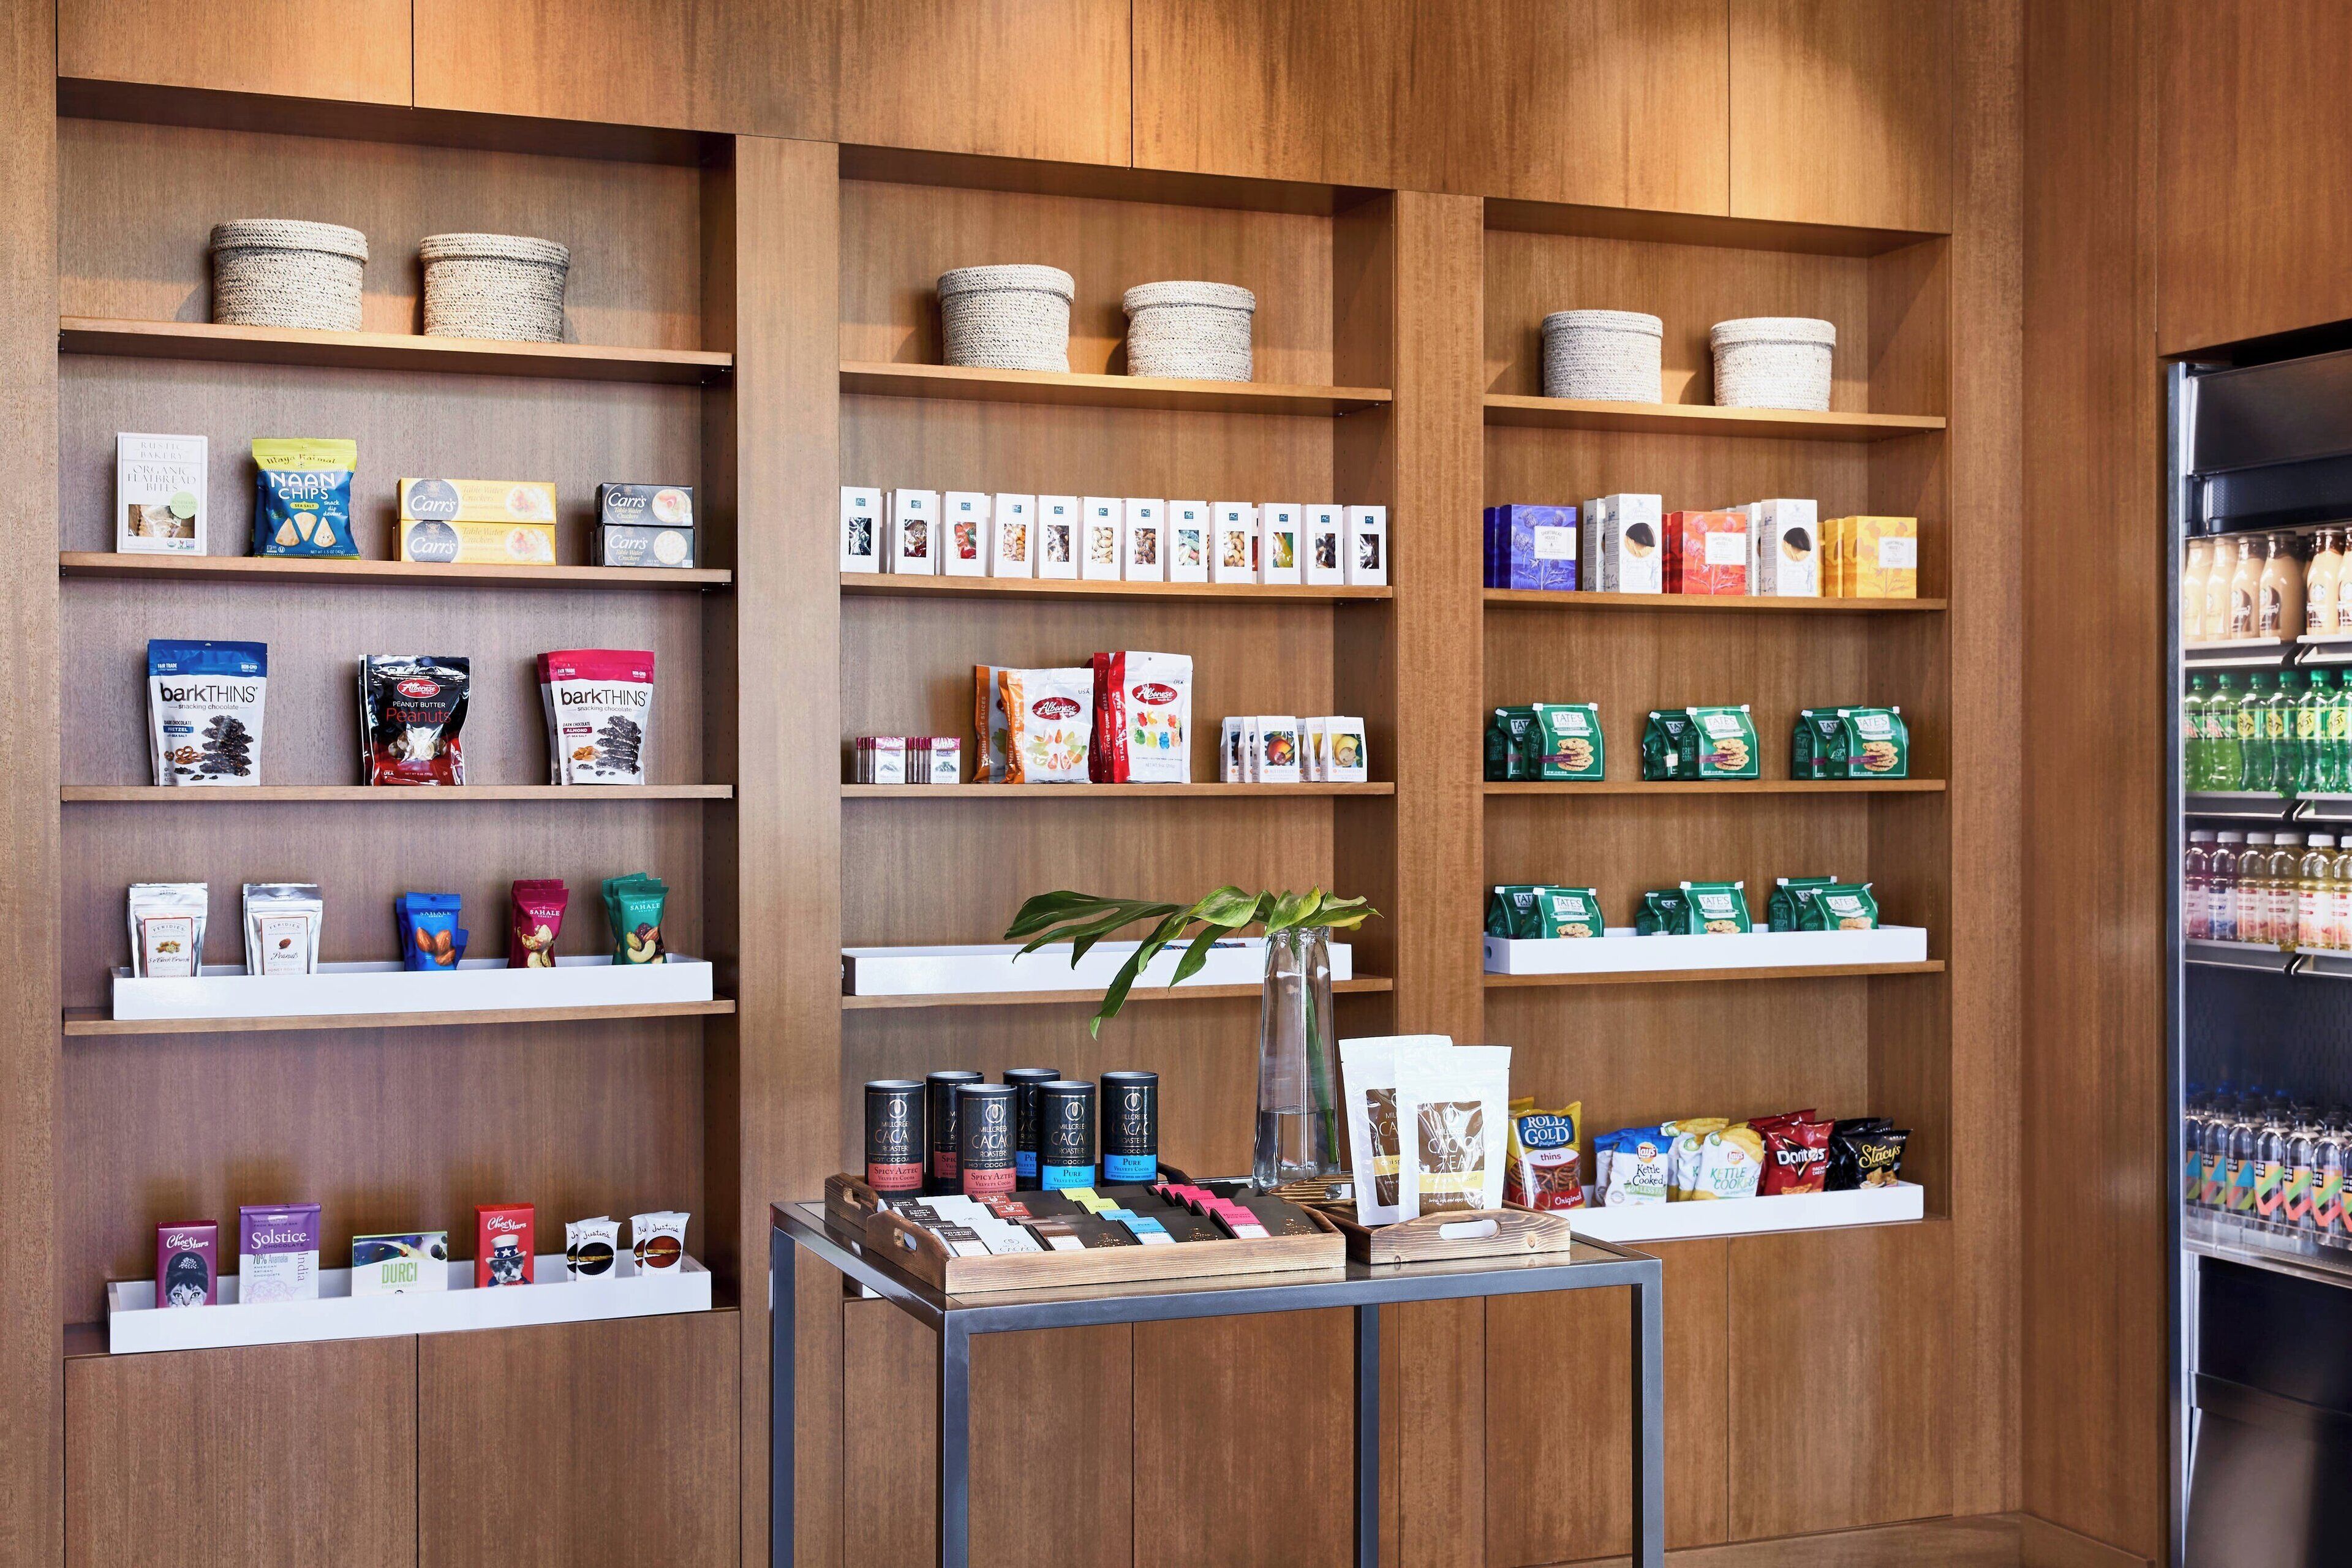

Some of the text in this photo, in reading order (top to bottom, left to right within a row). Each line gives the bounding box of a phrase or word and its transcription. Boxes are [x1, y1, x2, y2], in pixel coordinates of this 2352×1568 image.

[134, 465, 187, 475] ORGANIC
[270, 472, 336, 488] NAAN
[278, 488, 329, 500] CHIPS
[608, 492, 647, 507] Carr's
[411, 495, 456, 512] Carr's
[410, 537, 456, 554] Carr's
[609, 534, 648, 549] Carr's
[160, 683, 255, 703] barkTHINS
[401, 682, 436, 693] Albanese
[561, 688, 646, 707] barkTHINS
[386, 707, 451, 723] Peanuts
[1036, 701, 1076, 715] Albanese
[1554, 714, 1584, 723] TATE'S
[1707, 716, 1736, 726] TATE'S
[1858, 717, 1888, 728] TATE'S
[1555, 897, 1583, 908] TATE'S
[1700, 896, 1730, 905] TATE'S
[1828, 897, 1858, 907] TATE'S
[271, 951, 298, 960] Peanuts
[1528, 1115, 1566, 1129] ROLD
[971, 1134, 1013, 1149] CACAO
[1525, 1127, 1569, 1145] GOLD
[1428, 1136, 1476, 1154] CACAO
[1540, 1152, 1561, 1161] thins
[1776, 1148, 1826, 1166] Doritos
[1858, 1144, 1902, 1168] Stacy's
[1637, 1164, 1660, 1176] Kettle
[1711, 1167, 1747, 1179] KETTLE
[1632, 1175, 1664, 1186] Cooked
[1555, 1191, 1582, 1206] Original
[583, 1230, 611, 1240] Justin's
[652, 1224, 679, 1233] Justin's
[251, 1229, 307, 1249] Solstice
[253, 1254, 267, 1265] 70%
[298, 1251, 309, 1281] India
[382, 1262, 418, 1284] DURCI
